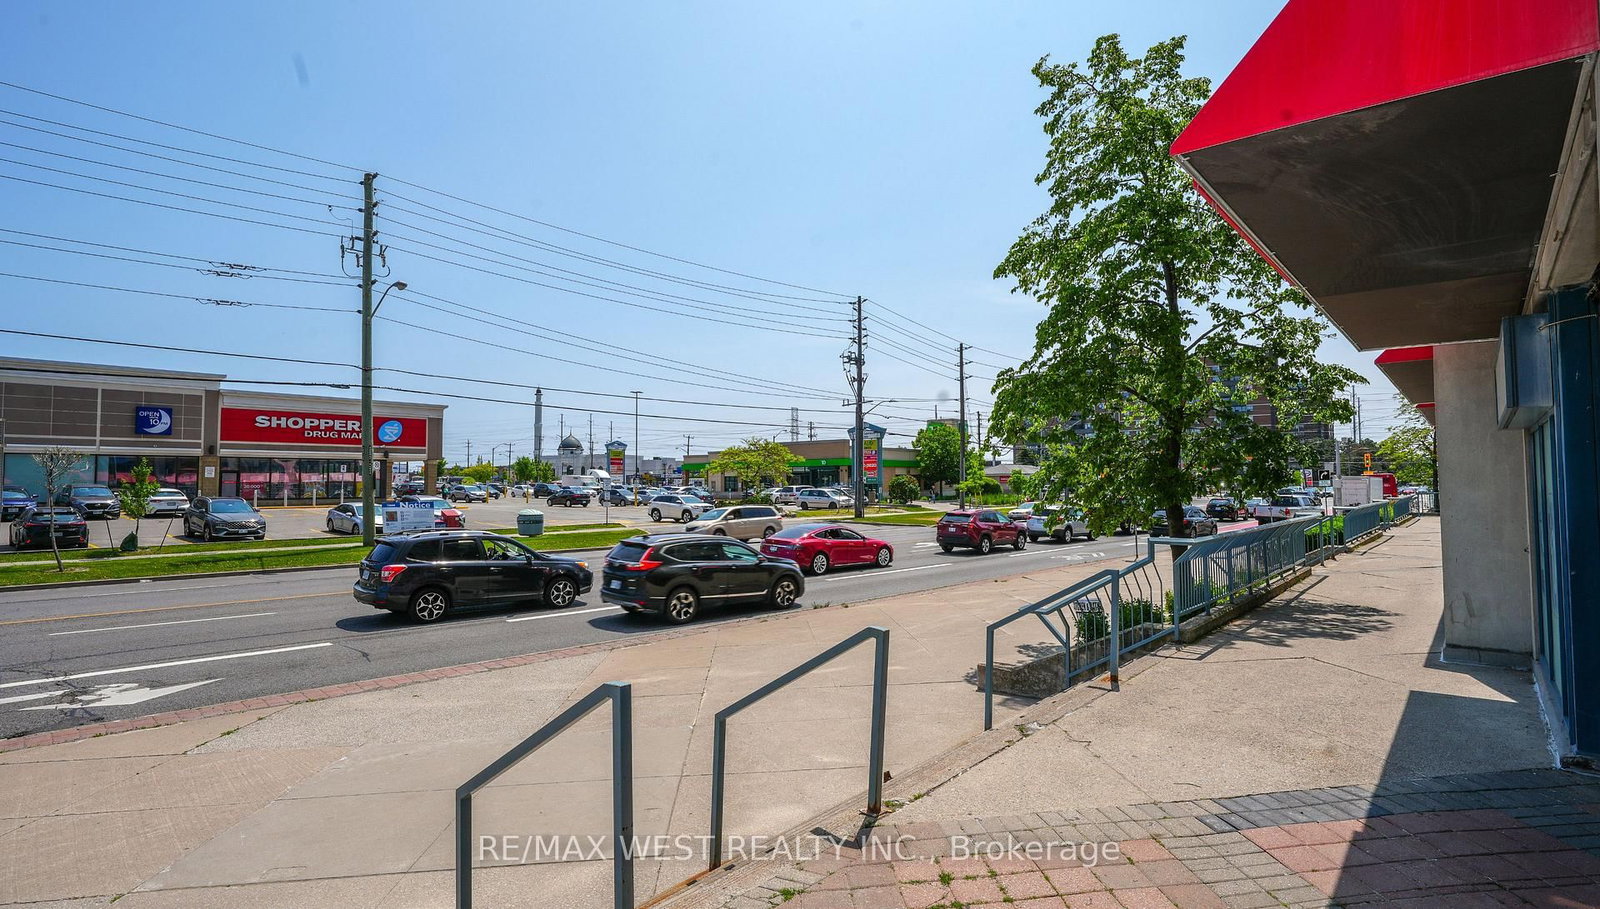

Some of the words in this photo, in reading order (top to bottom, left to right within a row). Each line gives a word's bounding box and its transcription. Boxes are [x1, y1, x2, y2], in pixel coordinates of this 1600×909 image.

[254, 415, 362, 431] SHOPPER
[304, 431, 339, 439] DRUG
[400, 501, 431, 509] Notice
